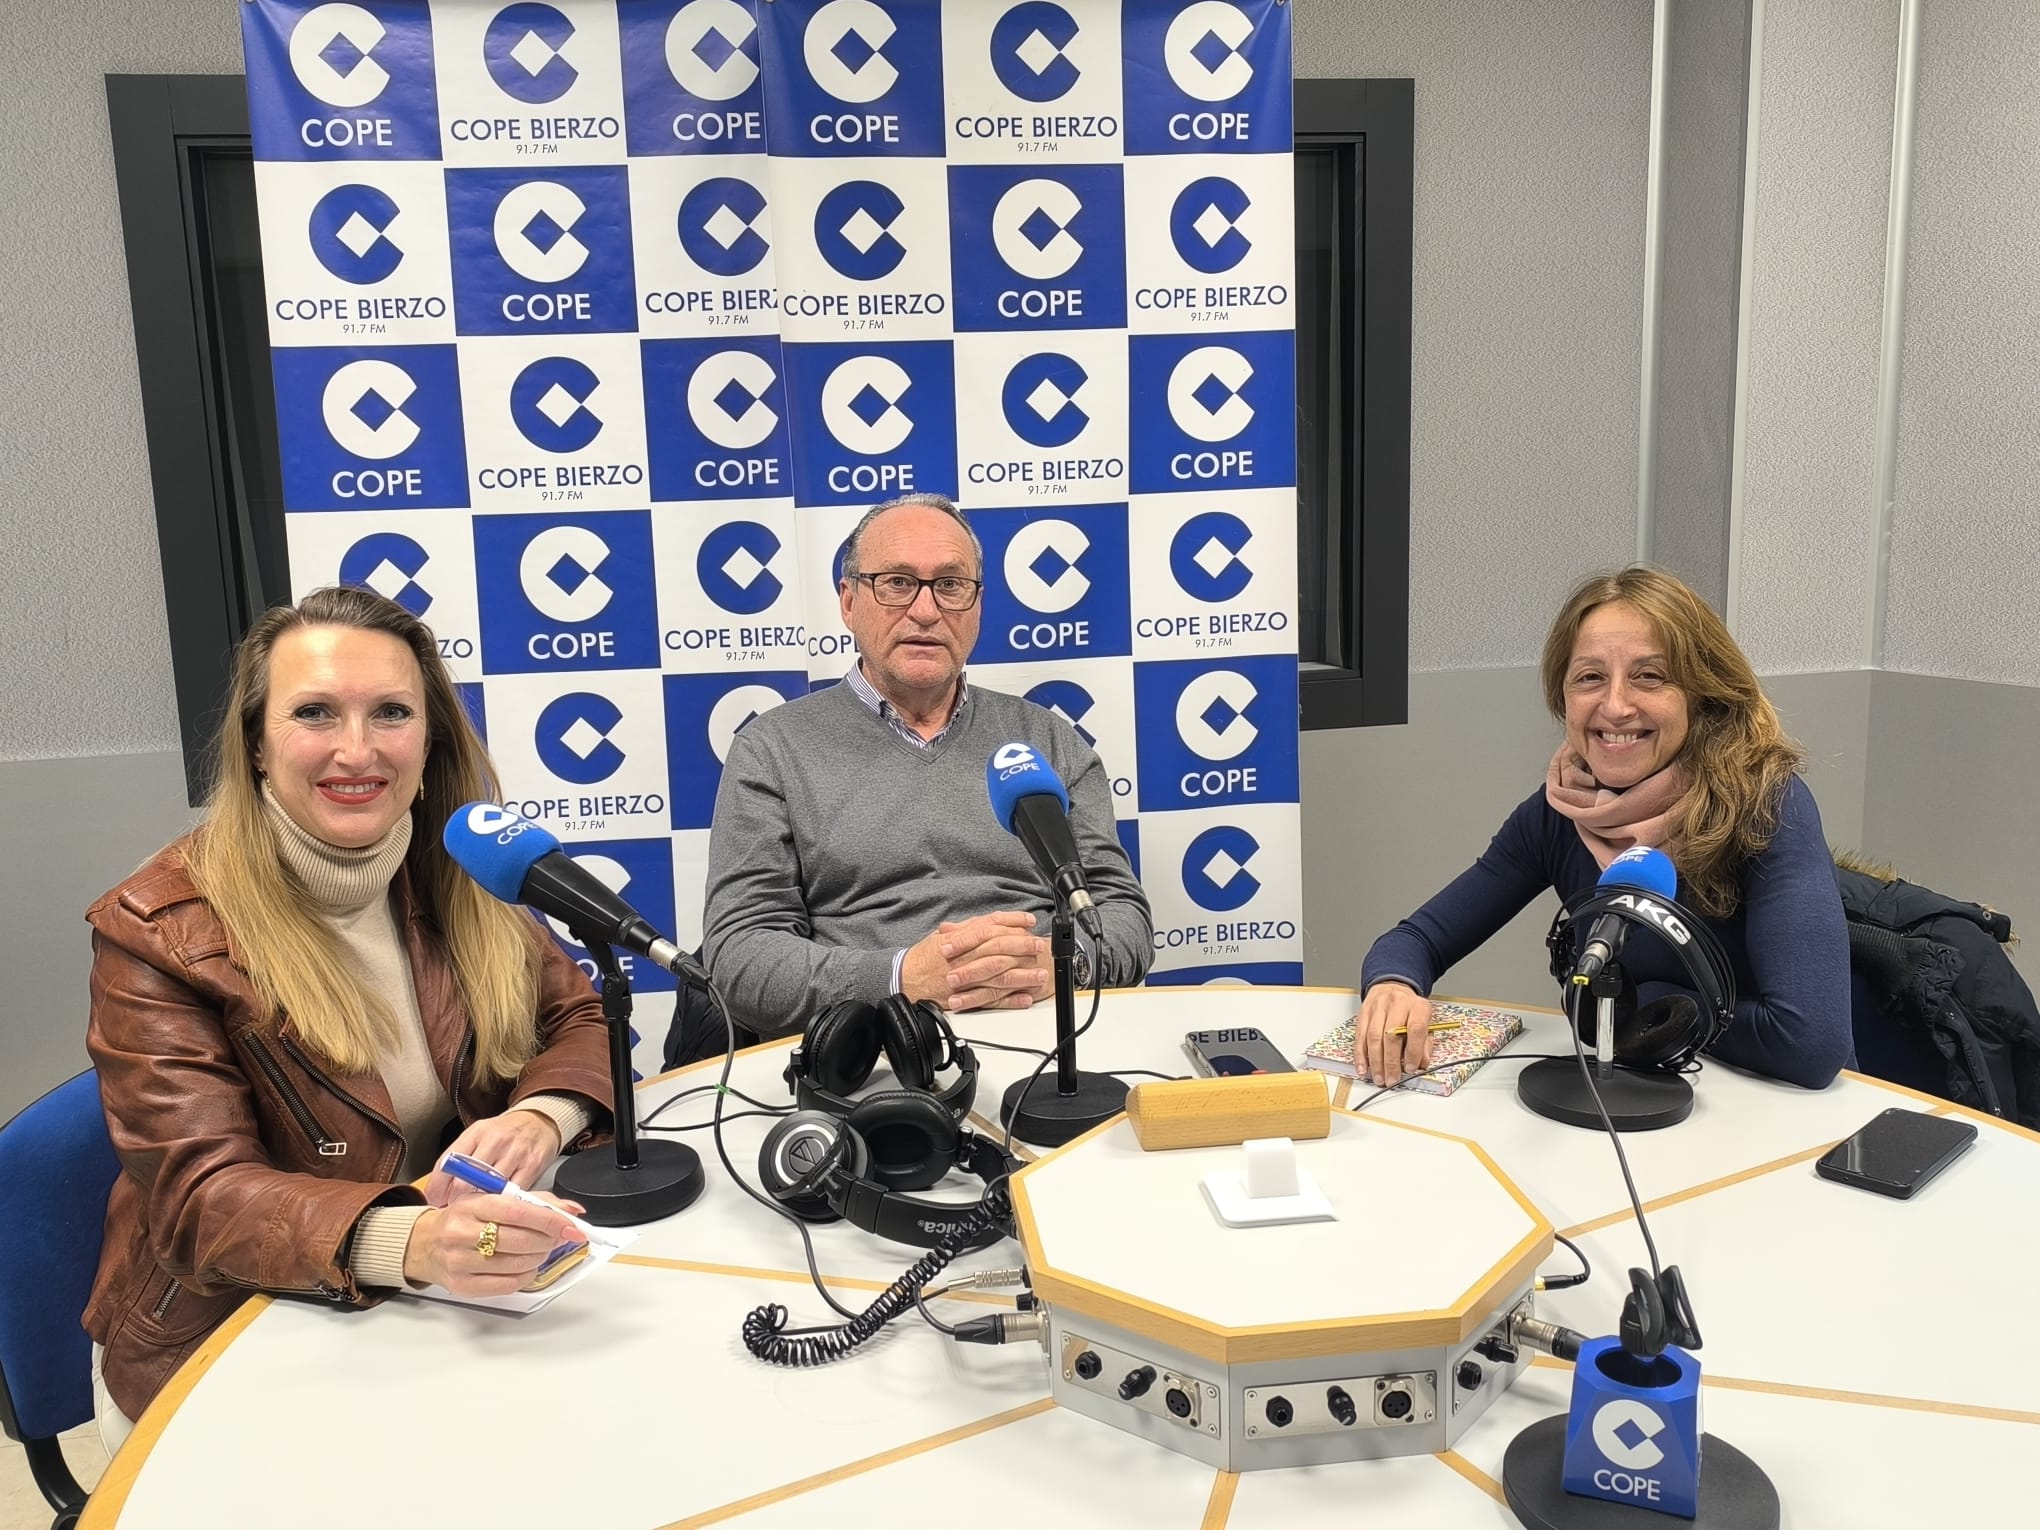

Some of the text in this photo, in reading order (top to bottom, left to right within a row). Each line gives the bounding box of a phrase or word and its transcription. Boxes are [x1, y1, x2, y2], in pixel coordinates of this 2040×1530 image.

[302, 119, 392, 147] COPE
[451, 117, 619, 140] COPE BIERZO
[673, 112, 761, 141] COPE
[811, 115, 899, 142] COPE
[956, 117, 1117, 138] COPE BIERZO
[1169, 113, 1248, 140] COPE
[517, 144, 557, 154] 91.7 FM
[1018, 142, 1057, 152] 91.7 FM
[276, 297, 445, 320] COPE BIERZO
[503, 294, 591, 321] COPE
[646, 292, 713, 313] COPE
[784, 294, 944, 316] COPE BIERZO
[998, 290, 1082, 317] COPE
[1136, 285, 1287, 309] COPE BIERZO
[709, 315, 748, 325] 91.7 FM
[844, 320, 883, 329] 91.7 FM
[1191, 312, 1228, 321] 91.7 FM
[343, 324, 385, 333] 91.7 FM
[695, 459, 779, 486] COPE
[968, 459, 1123, 483] COPE BIERZO
[1172, 451, 1252, 479] COPE
[333, 470, 421, 497] COPE
[479, 465, 642, 489] COPE BIERZO
[829, 465, 913, 492] COPE
[542, 491, 582, 500] 91.7 FM
[1028, 485, 1066, 494] 91.7 FM
[1009, 622, 1088, 649] COPE
[1137, 612, 1287, 637] COPE BIERZO
[529, 632, 614, 659] COPE
[665, 629, 730, 649] COPE
[1195, 638, 1231, 647] 91.7 FM
[726, 651, 764, 660] 91.7 FM
[1000, 762, 1041, 781] COPE
[1181, 768, 1256, 796] COPE
[580, 795, 664, 816] BIERZO
[565, 820, 604, 830] 91.7 FM
[1606, 894, 1691, 945] AKG
[1153, 921, 1295, 949] COPE BIERZO
[1203, 945, 1239, 955] 91.7 FM
[1593, 1469, 1661, 1501] COPE
